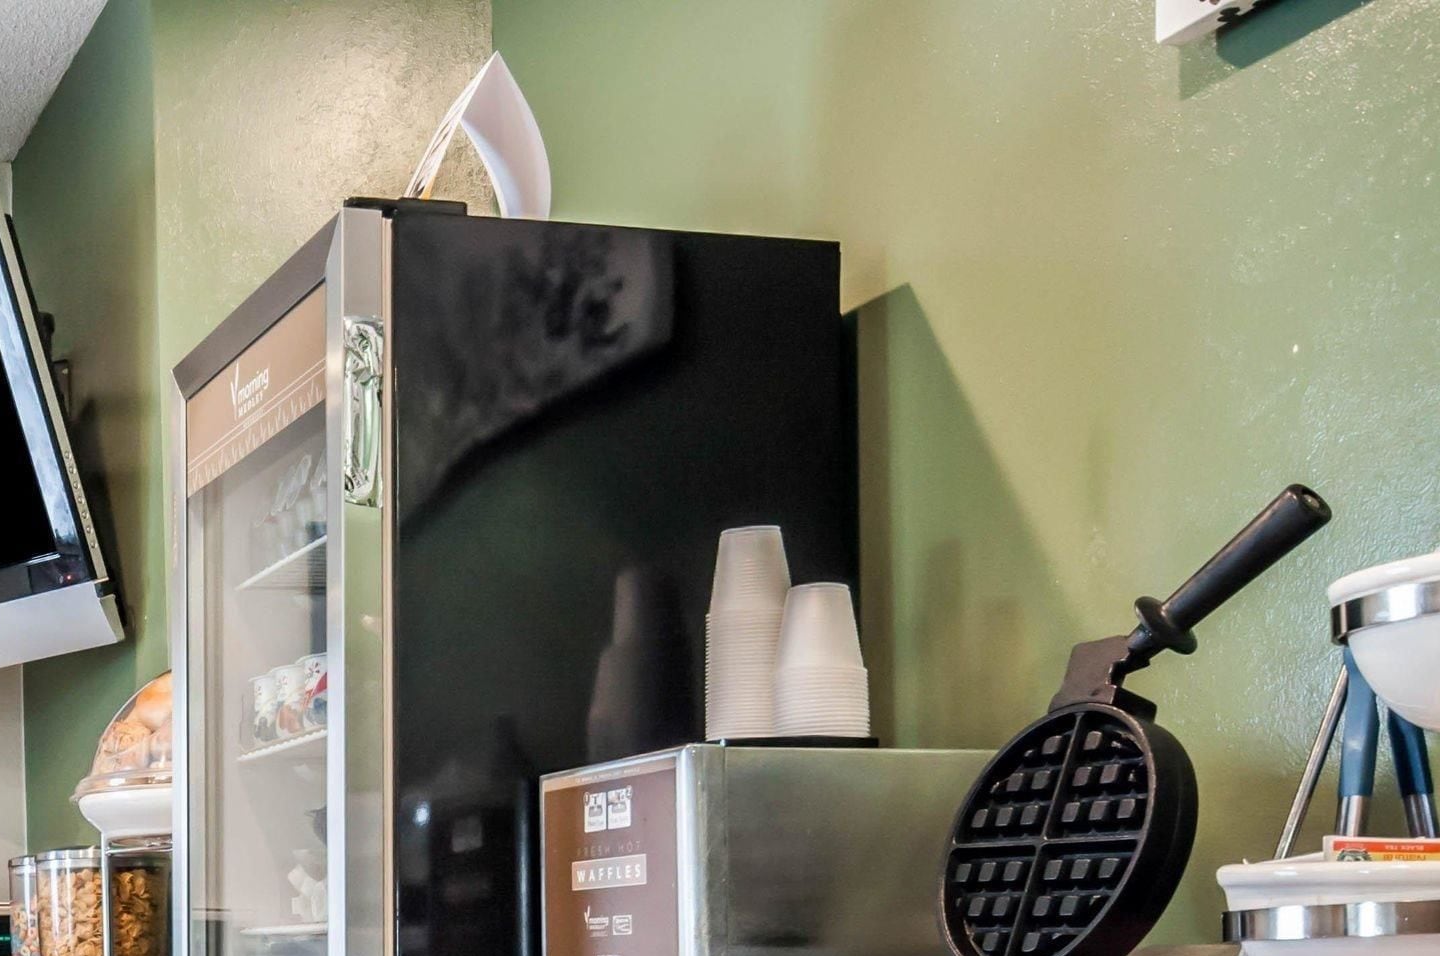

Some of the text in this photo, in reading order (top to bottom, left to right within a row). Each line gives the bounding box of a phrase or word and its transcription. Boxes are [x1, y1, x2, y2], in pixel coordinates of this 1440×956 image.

[238, 367, 269, 405] morning
[239, 390, 263, 418] MEDLEY
[576, 840, 641, 858] FRESH HOT
[576, 865, 642, 883] WAFFLES
